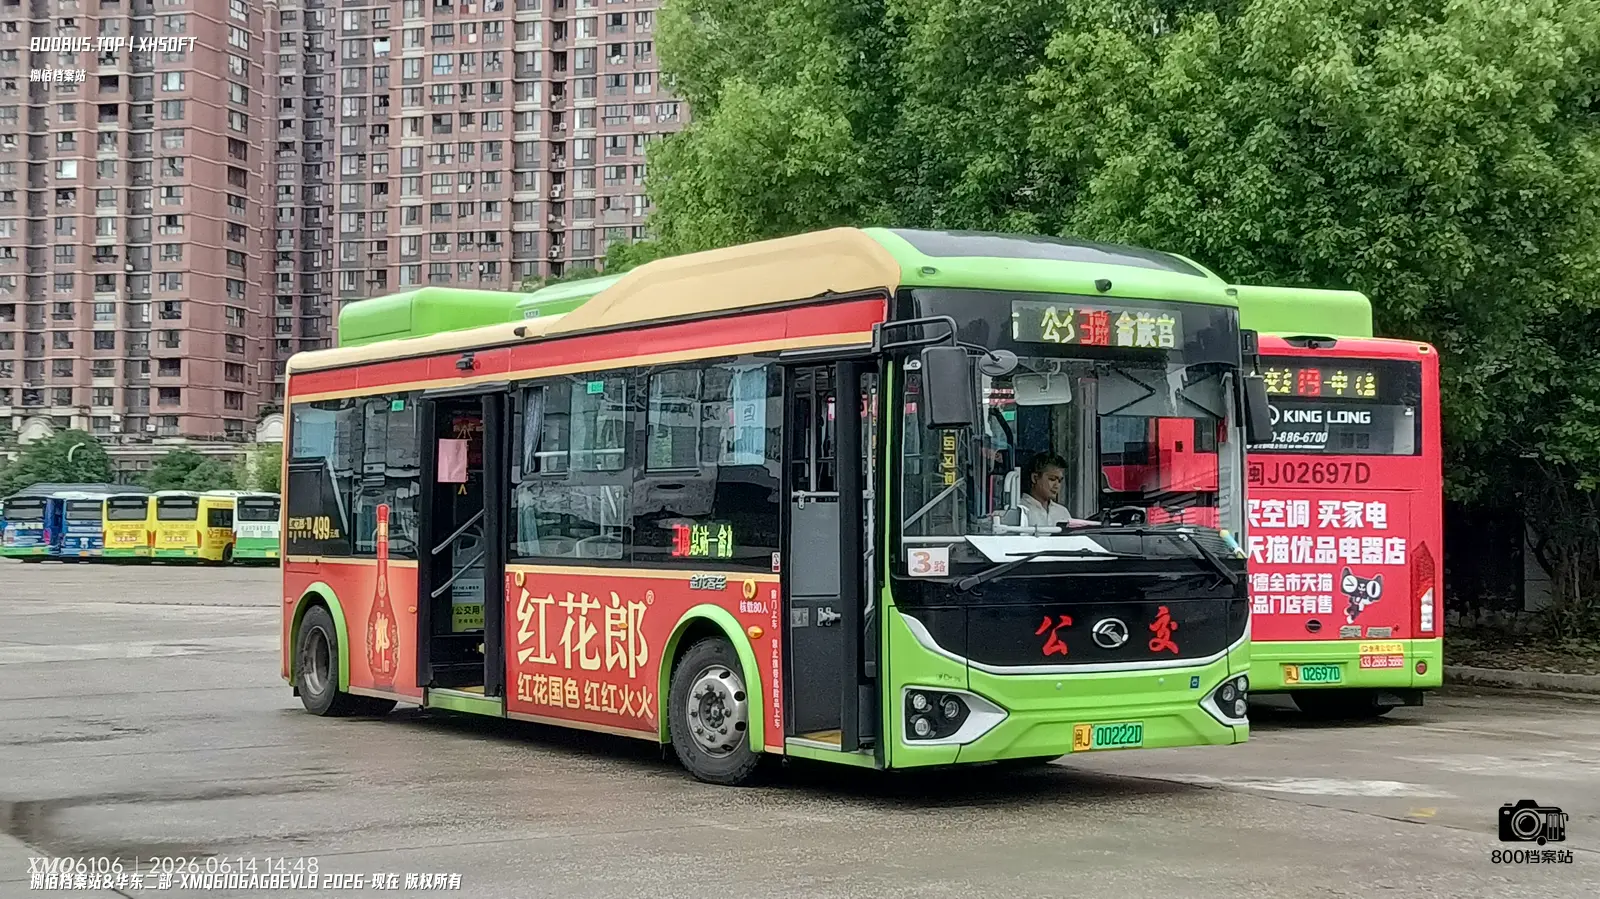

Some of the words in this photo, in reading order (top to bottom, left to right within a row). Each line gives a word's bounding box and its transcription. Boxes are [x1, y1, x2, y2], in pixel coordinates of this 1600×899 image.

[1283, 409, 1322, 423] KING
[1327, 411, 1371, 424] LONG
[1248, 499, 1311, 529] 买空调
[1317, 500, 1388, 529] 买家电
[1248, 535, 1406, 565] 天猫优品电器店
[1248, 573, 1333, 593] 德全市天猫
[516, 587, 649, 679] 红花郎
[1034, 615, 1074, 656] 公
[1148, 605, 1179, 655] 交
[517, 671, 581, 709] 红花国色
[584, 679, 655, 720] 红红火火
